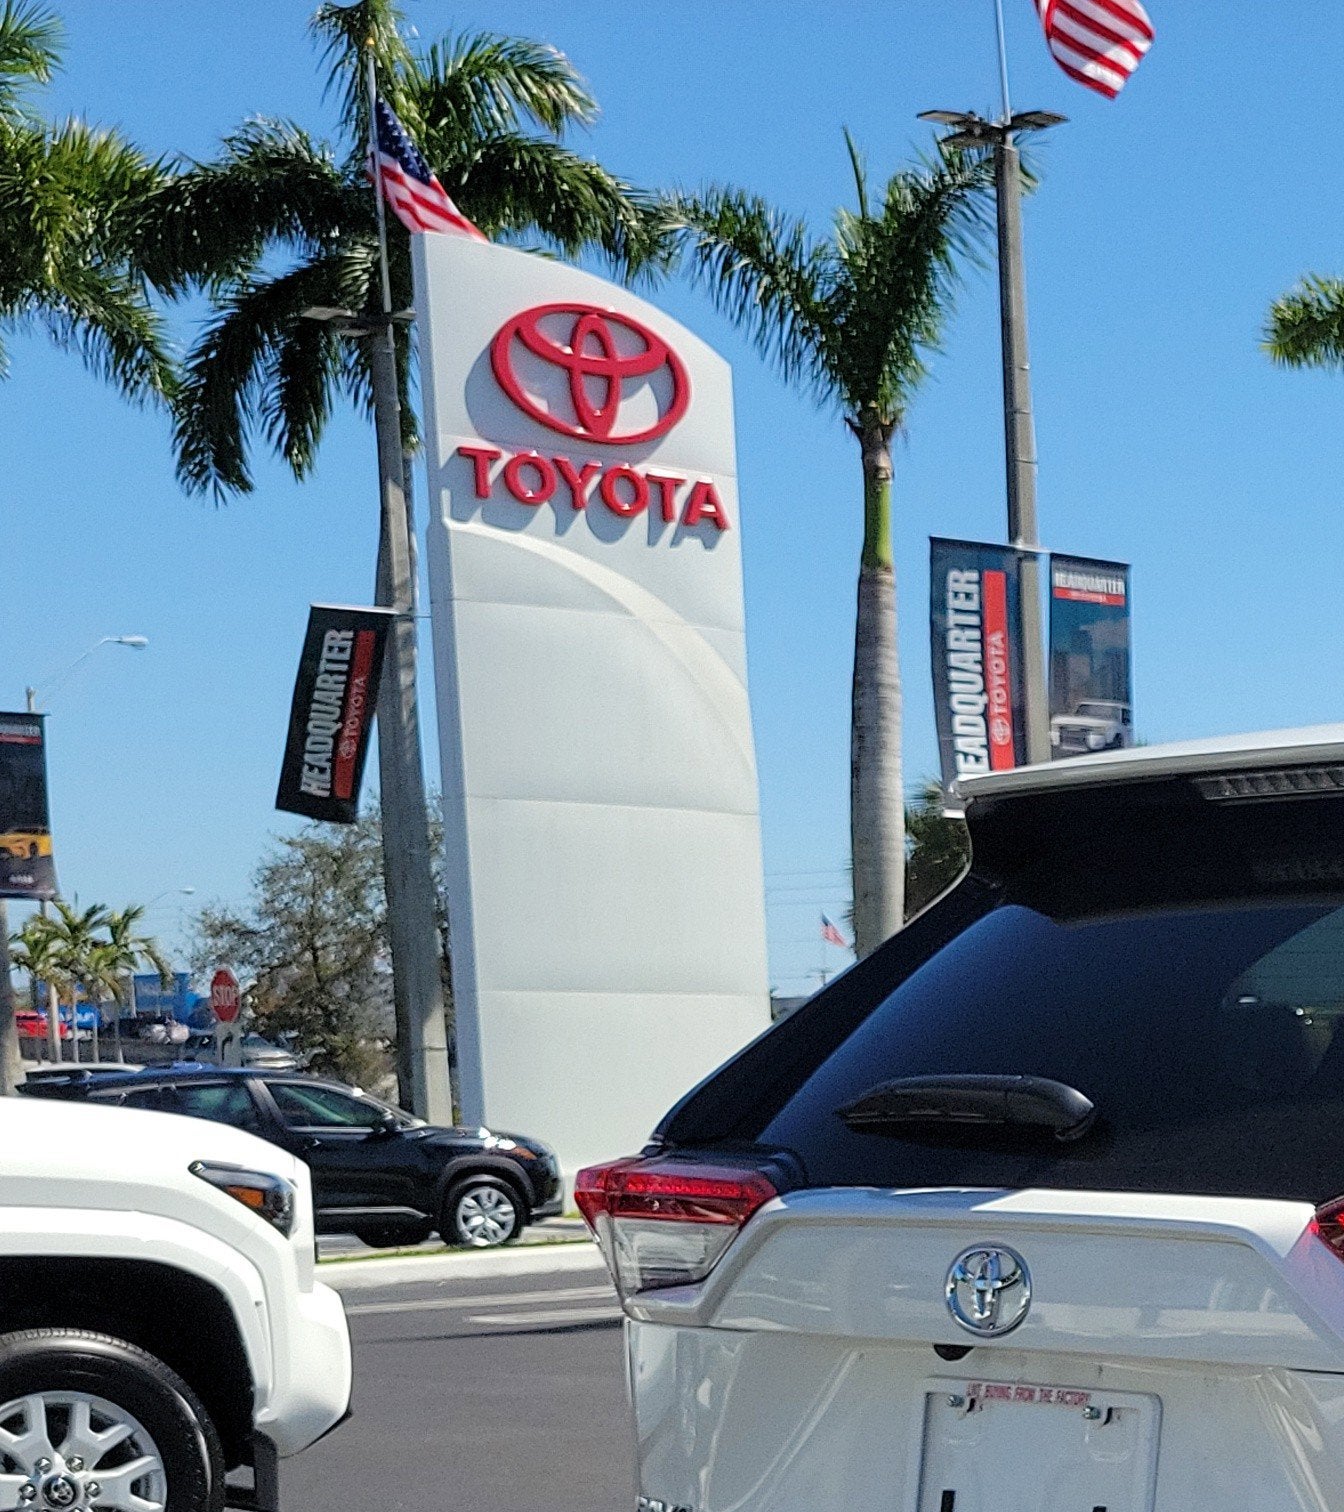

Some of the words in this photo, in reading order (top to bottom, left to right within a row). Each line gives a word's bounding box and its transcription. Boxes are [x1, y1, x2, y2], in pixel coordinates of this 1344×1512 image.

[457, 445, 732, 531] TOYOTA
[301, 628, 353, 798] HEADQUARTER
[947, 568, 990, 776] EADQUARTER
[990, 631, 1008, 714] TOYOTA
[213, 985, 239, 1007] STOP
